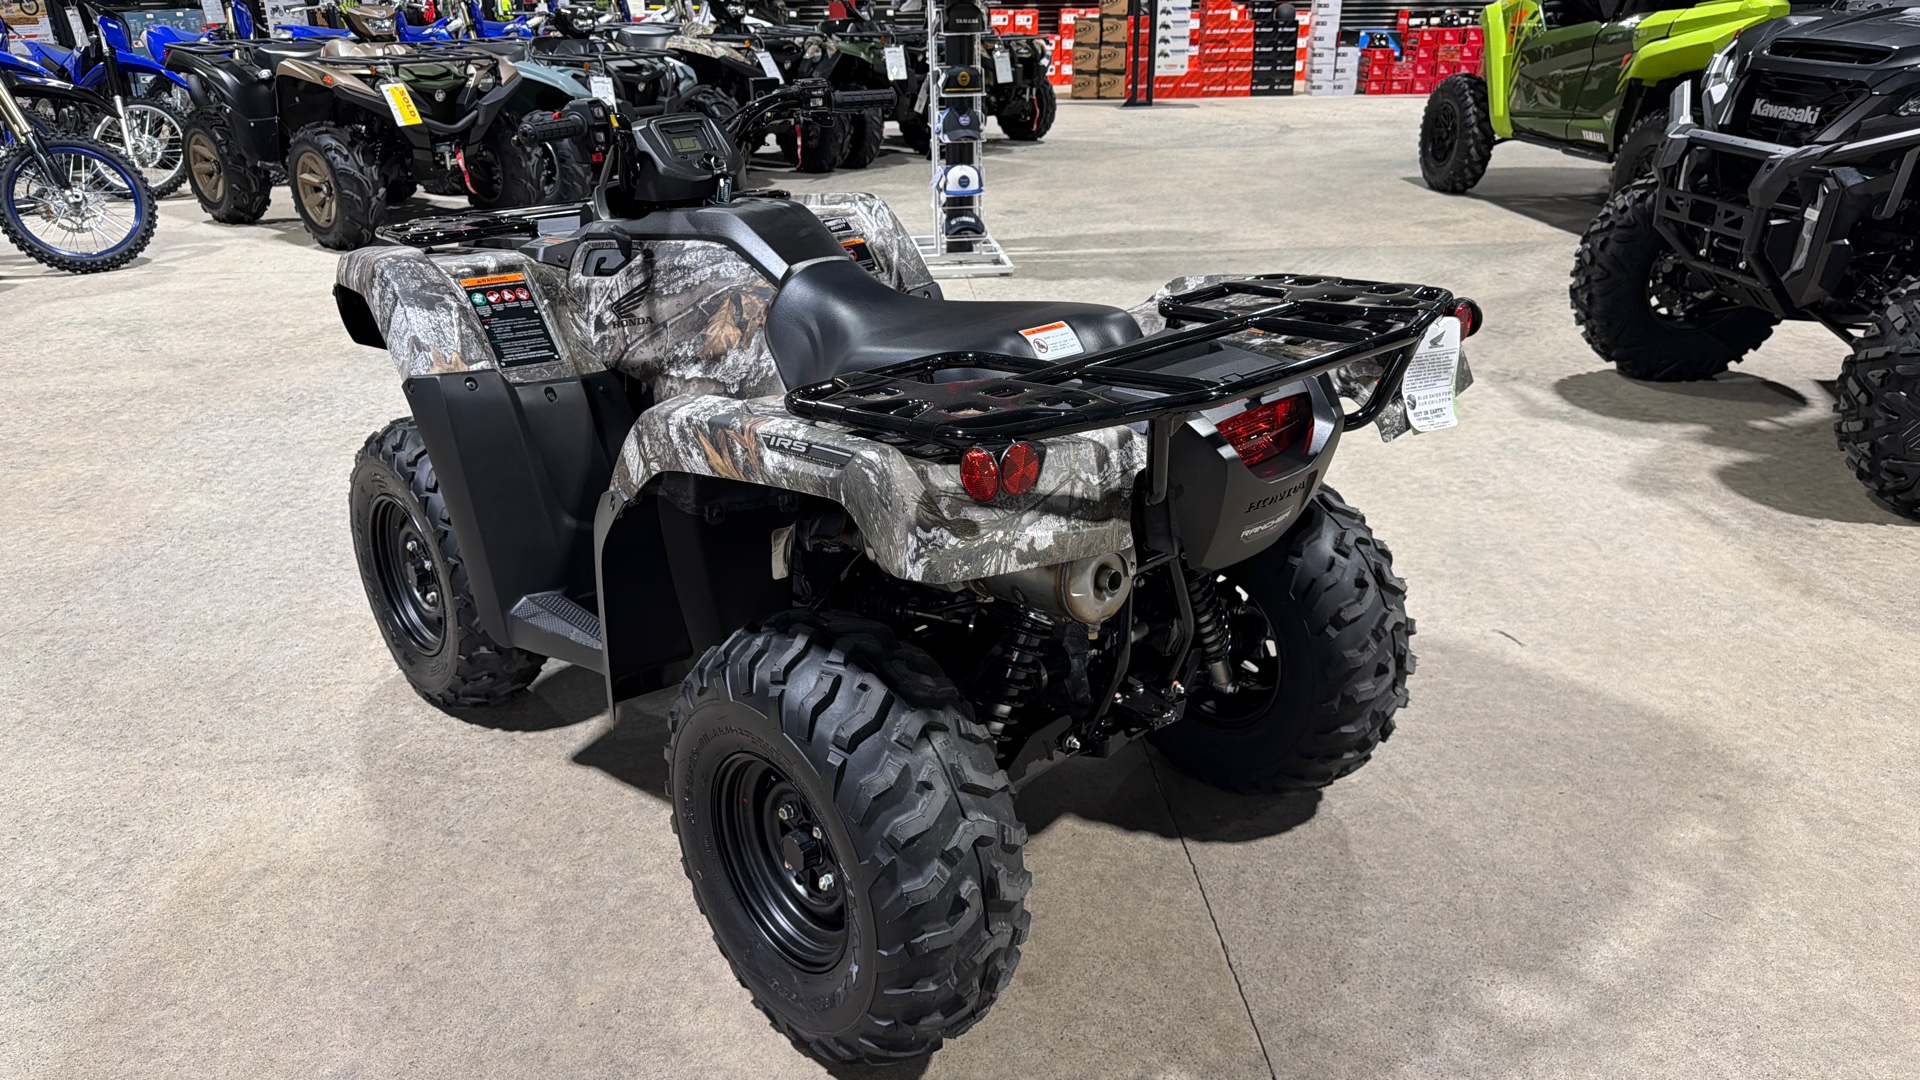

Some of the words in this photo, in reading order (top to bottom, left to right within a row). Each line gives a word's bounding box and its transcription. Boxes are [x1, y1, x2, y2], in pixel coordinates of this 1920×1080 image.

[399, 90, 417, 118] SOLD
[1751, 98, 1821, 125] Kawasaki
[1582, 129, 1606, 143] YAMAHA
[612, 316, 655, 329] HONDA
[769, 436, 808, 453] IRS
[1244, 481, 1306, 514] HONDA
[1241, 509, 1292, 538] RANCHER
